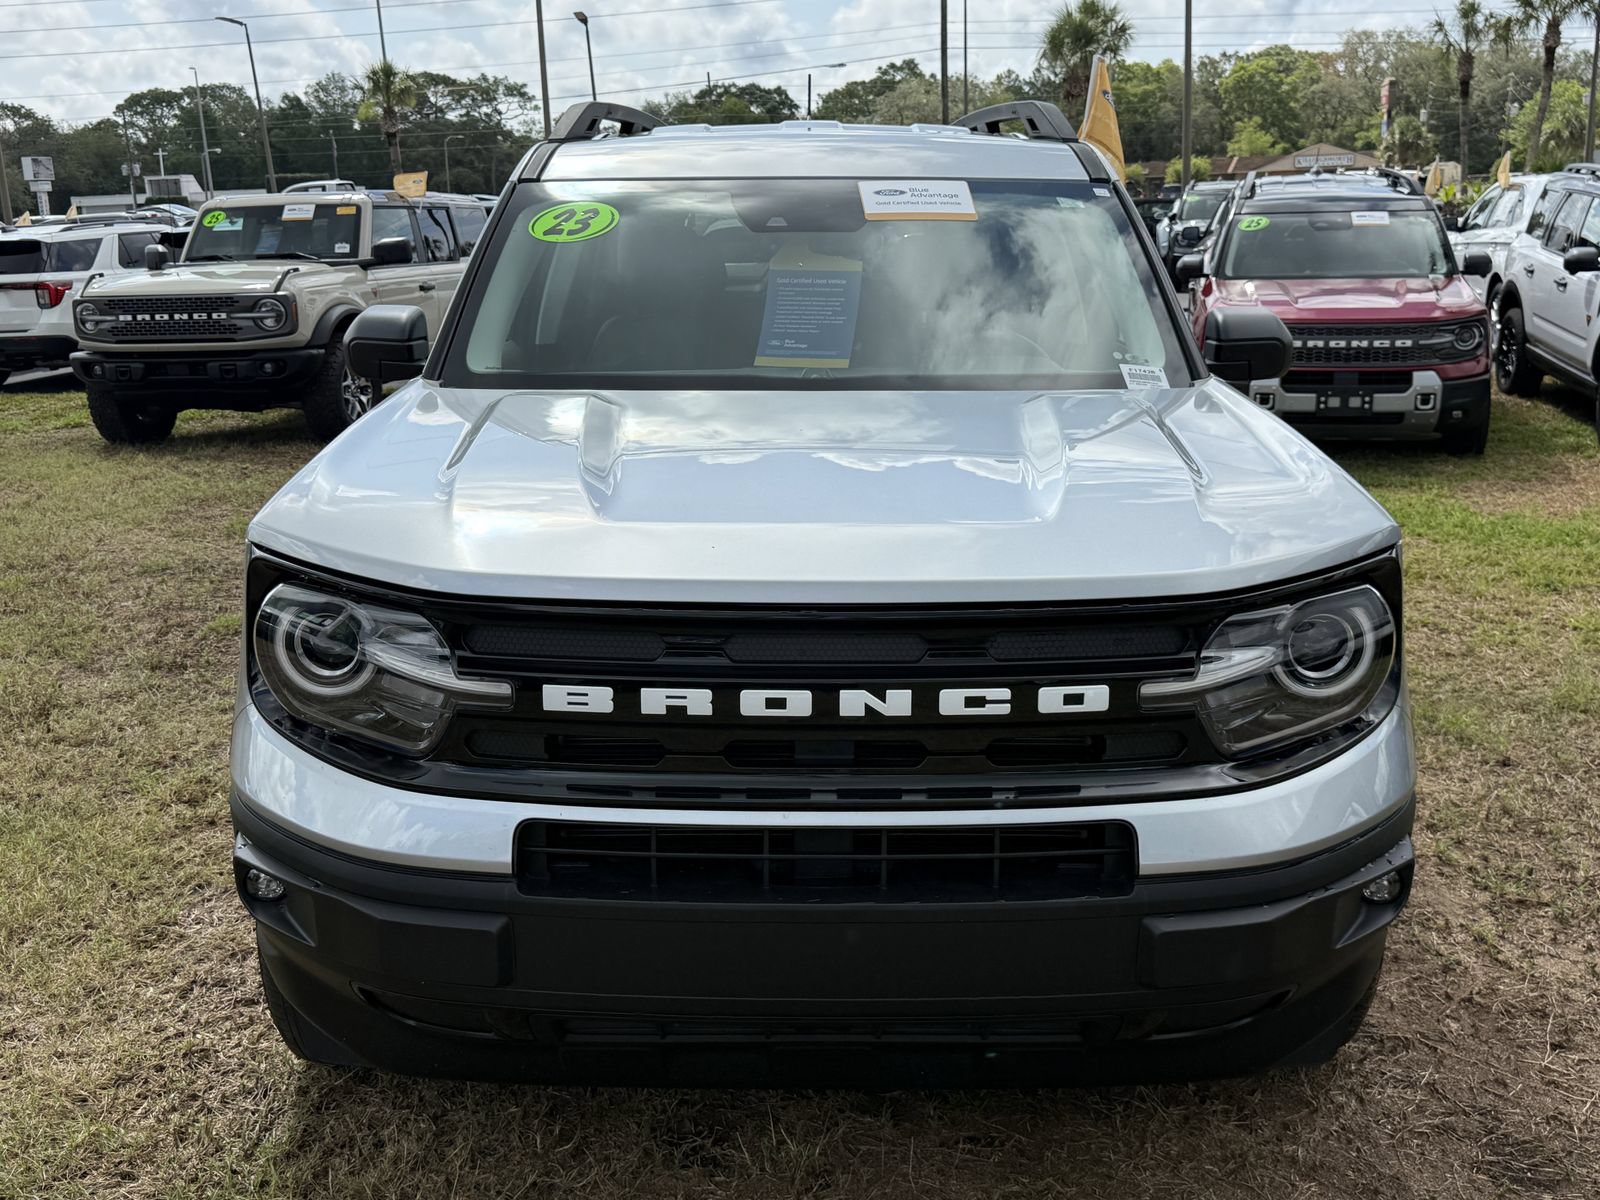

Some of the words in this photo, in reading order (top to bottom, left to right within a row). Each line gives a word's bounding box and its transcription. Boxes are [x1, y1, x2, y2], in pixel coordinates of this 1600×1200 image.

[206, 212, 223, 225] 25
[542, 208, 600, 236] 23
[1244, 218, 1264, 228] 25
[118, 312, 227, 321] BRONCO
[542, 684, 1110, 717] BRONCO
